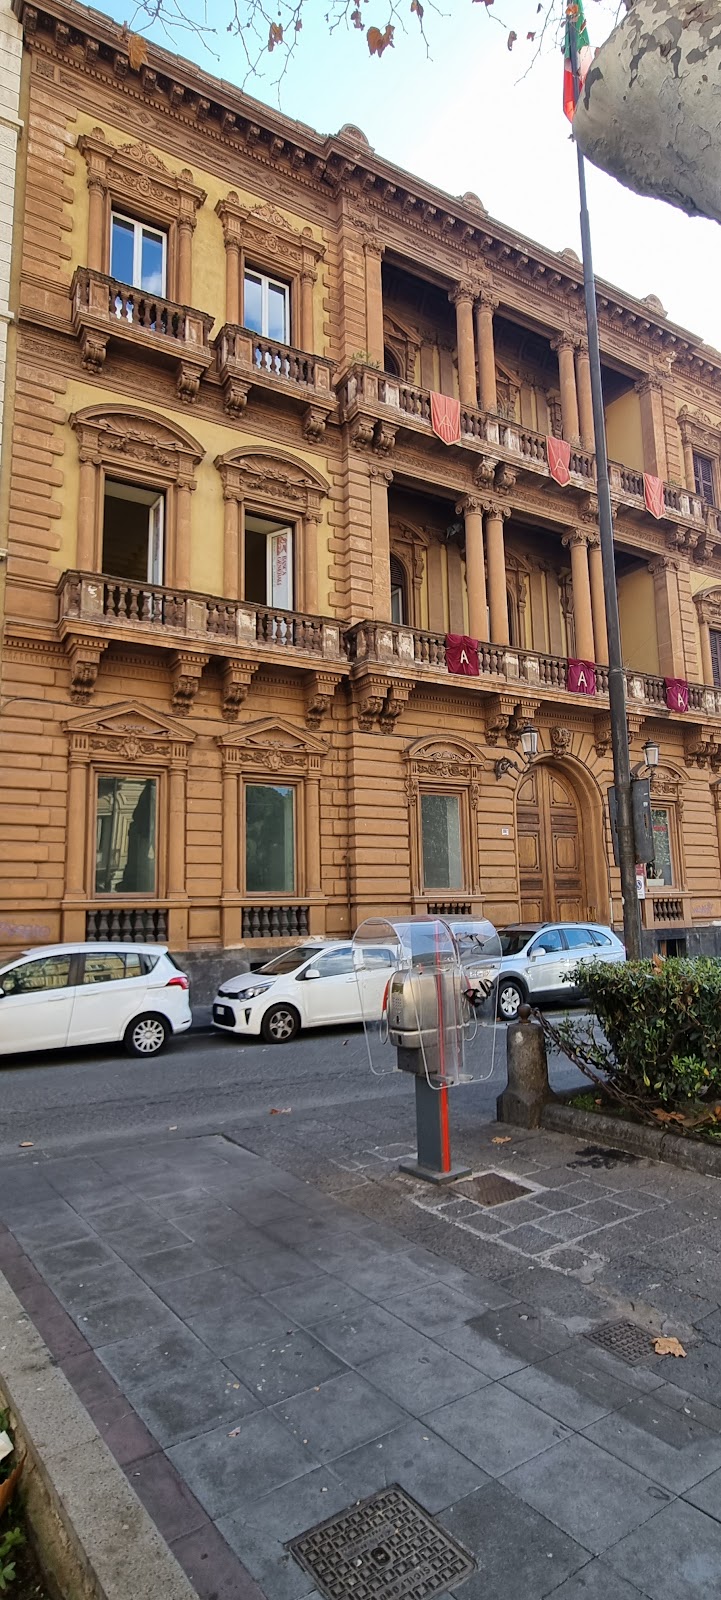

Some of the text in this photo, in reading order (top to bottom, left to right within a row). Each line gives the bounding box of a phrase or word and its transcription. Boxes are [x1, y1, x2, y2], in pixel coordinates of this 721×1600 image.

[460, 649, 470, 664] A
[577, 671, 588, 687] A
[677, 692, 686, 709] A
